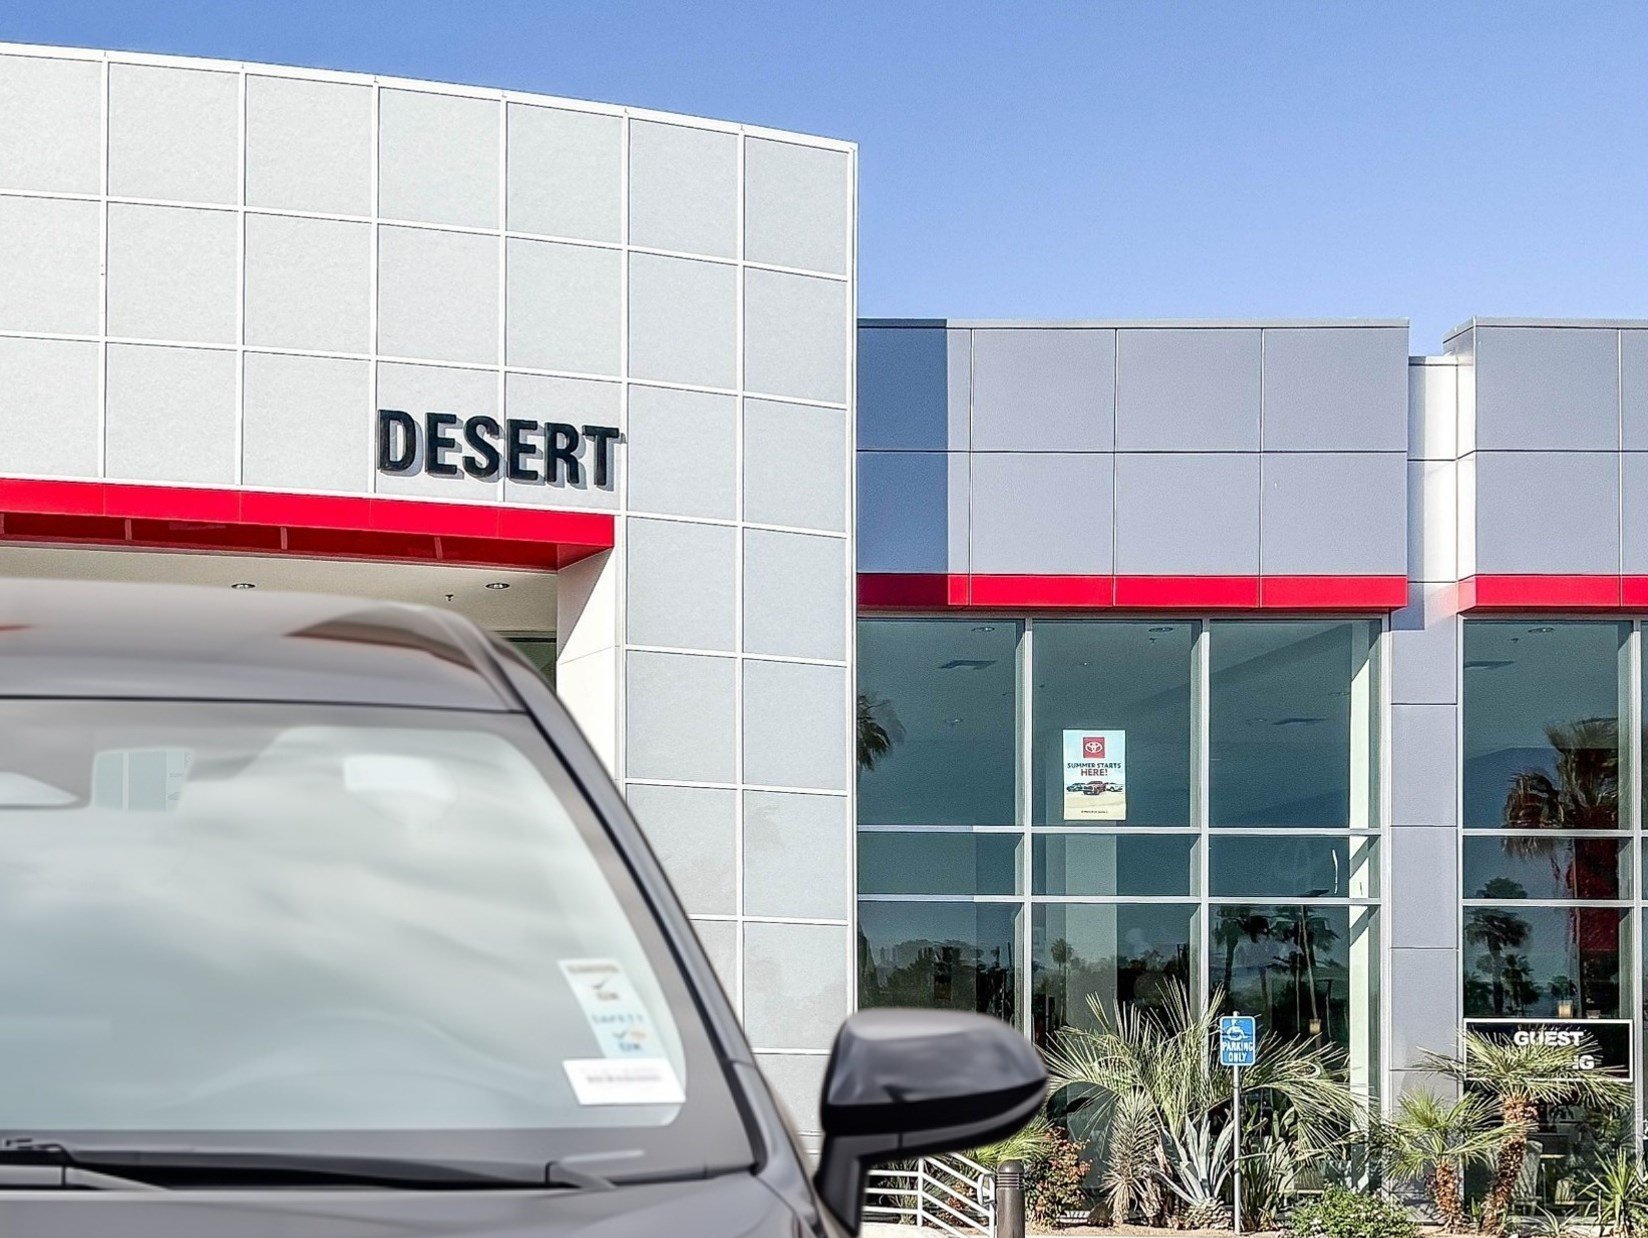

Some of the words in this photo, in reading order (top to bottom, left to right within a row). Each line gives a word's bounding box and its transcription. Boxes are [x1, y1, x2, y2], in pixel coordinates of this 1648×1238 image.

[377, 409, 620, 487] DESERT
[1081, 768, 1108, 776] HERE!
[1513, 1030, 1584, 1046] GUEST
[1222, 1041, 1253, 1052] PARKING
[1228, 1052, 1247, 1062] ONLY
